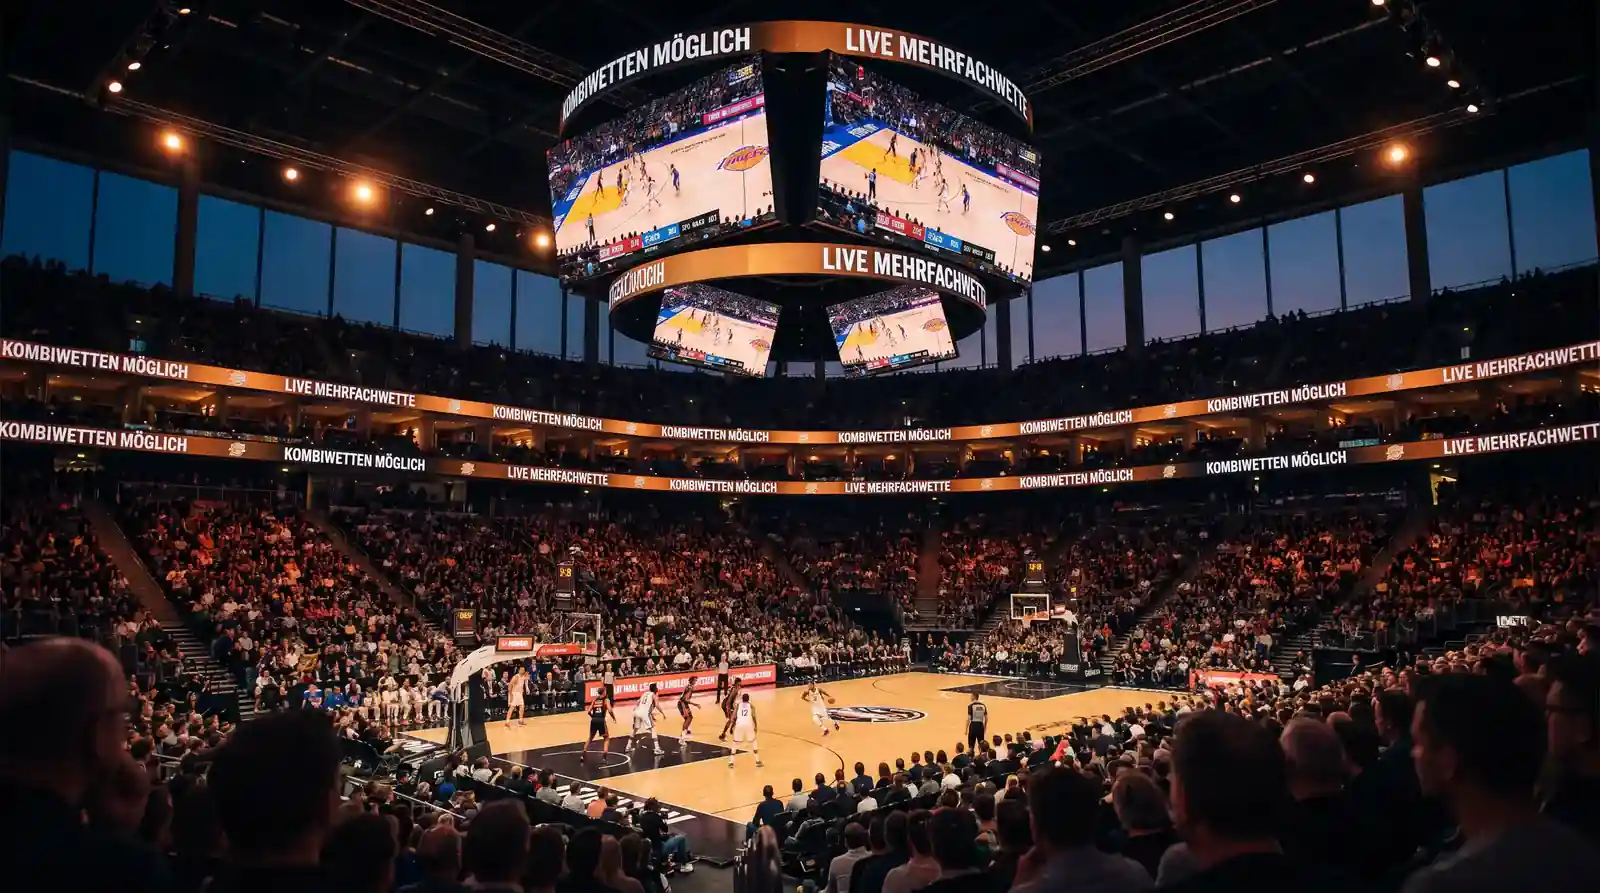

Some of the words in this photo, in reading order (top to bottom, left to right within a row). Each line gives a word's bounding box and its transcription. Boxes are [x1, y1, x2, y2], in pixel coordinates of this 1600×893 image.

[562, 47, 648, 121] KOMBIWETTEN
[654, 27, 751, 67] MÖGLICH
[847, 28, 893, 56] LIVE
[899, 35, 1028, 120] MEHRFACHWETTE
[824, 248, 868, 272] LIVE
[2, 340, 119, 370] KOMBIWETTEN
[123, 356, 188, 378] MÖGLICH
[1443, 365, 1473, 383] LIVE
[285, 378, 312, 394] LIVE
[315, 382, 415, 407] MEHRFACHWETTE
[1208, 391, 1288, 412] KOMBIWETTEN
[1292, 383, 1346, 401] MÖGLICH
[493, 406, 560, 425] KOMBIWETTEN
[563, 414, 601, 430] MÖGLICH
[1020, 416, 1087, 434] KOMBIWETTEN
[1089, 410, 1132, 426] MÖGLICH
[0, 422, 117, 447] KOMBIWETTEN
[120, 430, 188, 452] MÖGLICH
[662, 426, 726, 440] KOMBIWETTEN
[728, 428, 768, 442] MÖGLICH
[839, 431, 906, 442] KOMBIWETTEN
[908, 426, 952, 440] MÖGLICH
[1444, 439, 1474, 454] LIVE
[284, 447, 373, 467] KOMBIWETTEN
[375, 453, 425, 471] MÖGLICH
[1207, 456, 1289, 475] KOMBIWETTEN
[1292, 451, 1346, 467] MÖGLICH
[508, 466, 528, 479] LIVE
[531, 468, 608, 485] MEHRFACHWETTE
[670, 480, 733, 492] KOMBIWETTEN
[736, 480, 776, 492] MÖGLICH
[844, 481, 866, 493] LIVE
[868, 481, 951, 492] MEHRFACHWETTE
[1020, 473, 1087, 488] KOMBIWETTEN
[1090, 469, 1133, 483] MÖGLICH
[741, 709, 749, 717] 12
